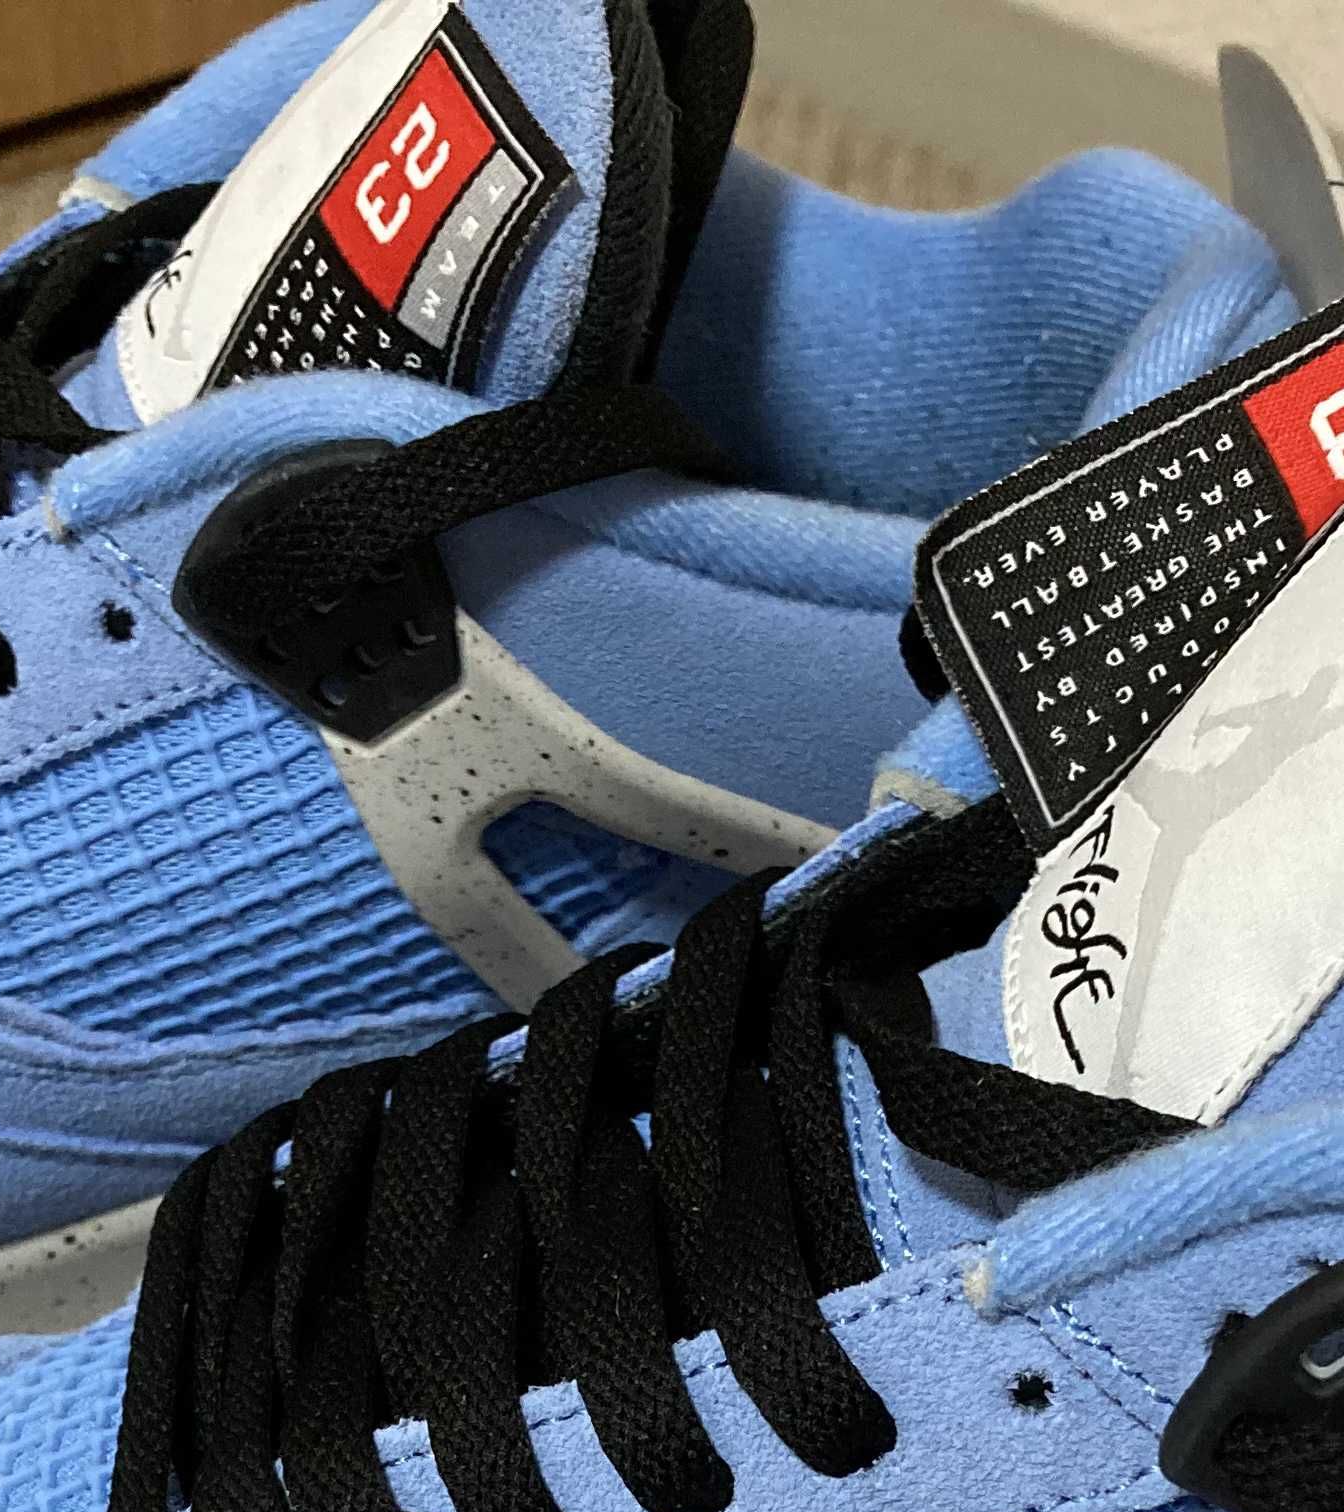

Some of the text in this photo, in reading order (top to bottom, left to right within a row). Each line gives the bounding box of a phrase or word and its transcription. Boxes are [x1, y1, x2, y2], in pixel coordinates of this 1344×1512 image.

[355, 101, 451, 244] 23
[419, 184, 506, 319] TEAM
[963, 432, 1234, 589] PLAYER EVER.
[991, 467, 1255, 628] BASKETBALL
[1017, 508, 1273, 673] THE GREATEST
[1036, 537, 1286, 713] INSPIRED BY
[1049, 563, 1287, 747] ODUCTS
[1041, 804, 1128, 1075] Flight
